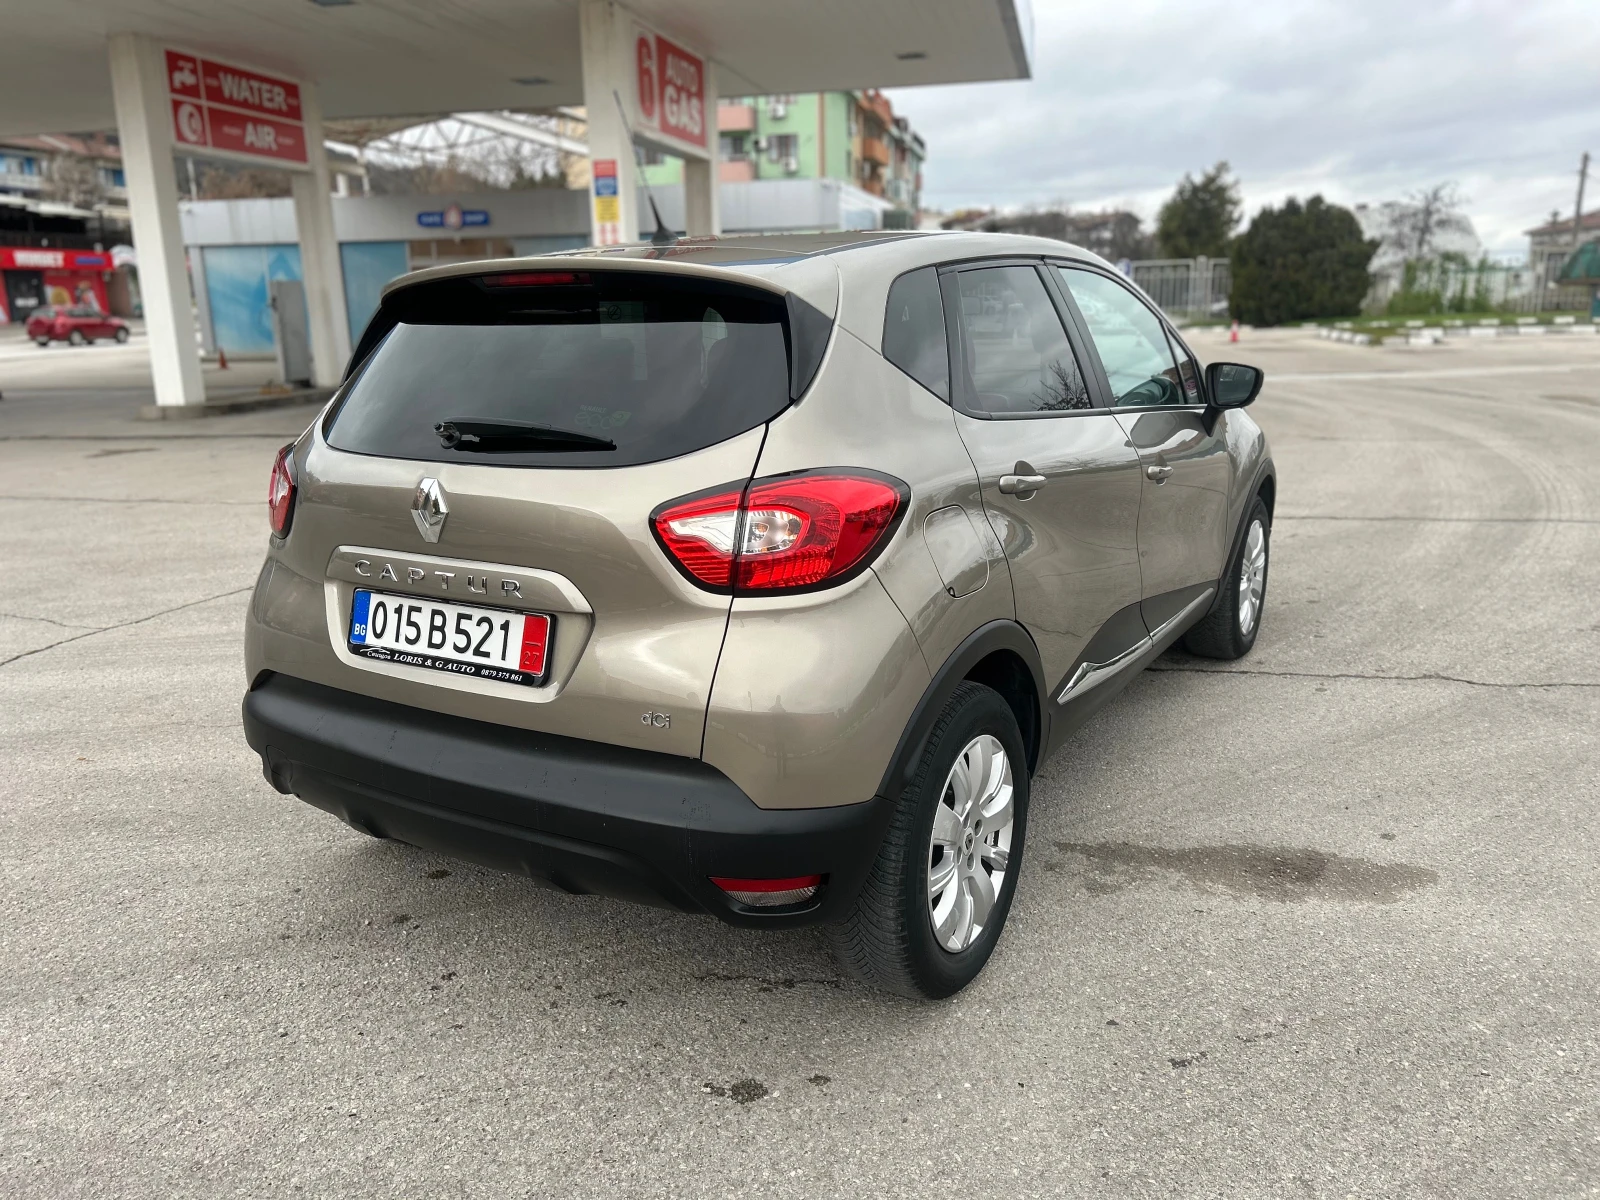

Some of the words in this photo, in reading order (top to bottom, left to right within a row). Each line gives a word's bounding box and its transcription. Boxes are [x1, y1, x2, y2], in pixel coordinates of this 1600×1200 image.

[665, 52, 699, 92] AUTO
[216, 71, 288, 112] WATER
[664, 84, 702, 135] GAS
[244, 121, 279, 151] AIR
[575, 412, 613, 430] eco
[354, 559, 523, 599] CAPTUR
[354, 623, 366, 636] BG
[393, 653, 423, 665] LORIS
[435, 660, 444, 668] G
[444, 662, 475, 673] AUTO
[480, 668, 497, 677] 0879
[497, 671, 510, 679] 375
[510, 673, 522, 682] 861
